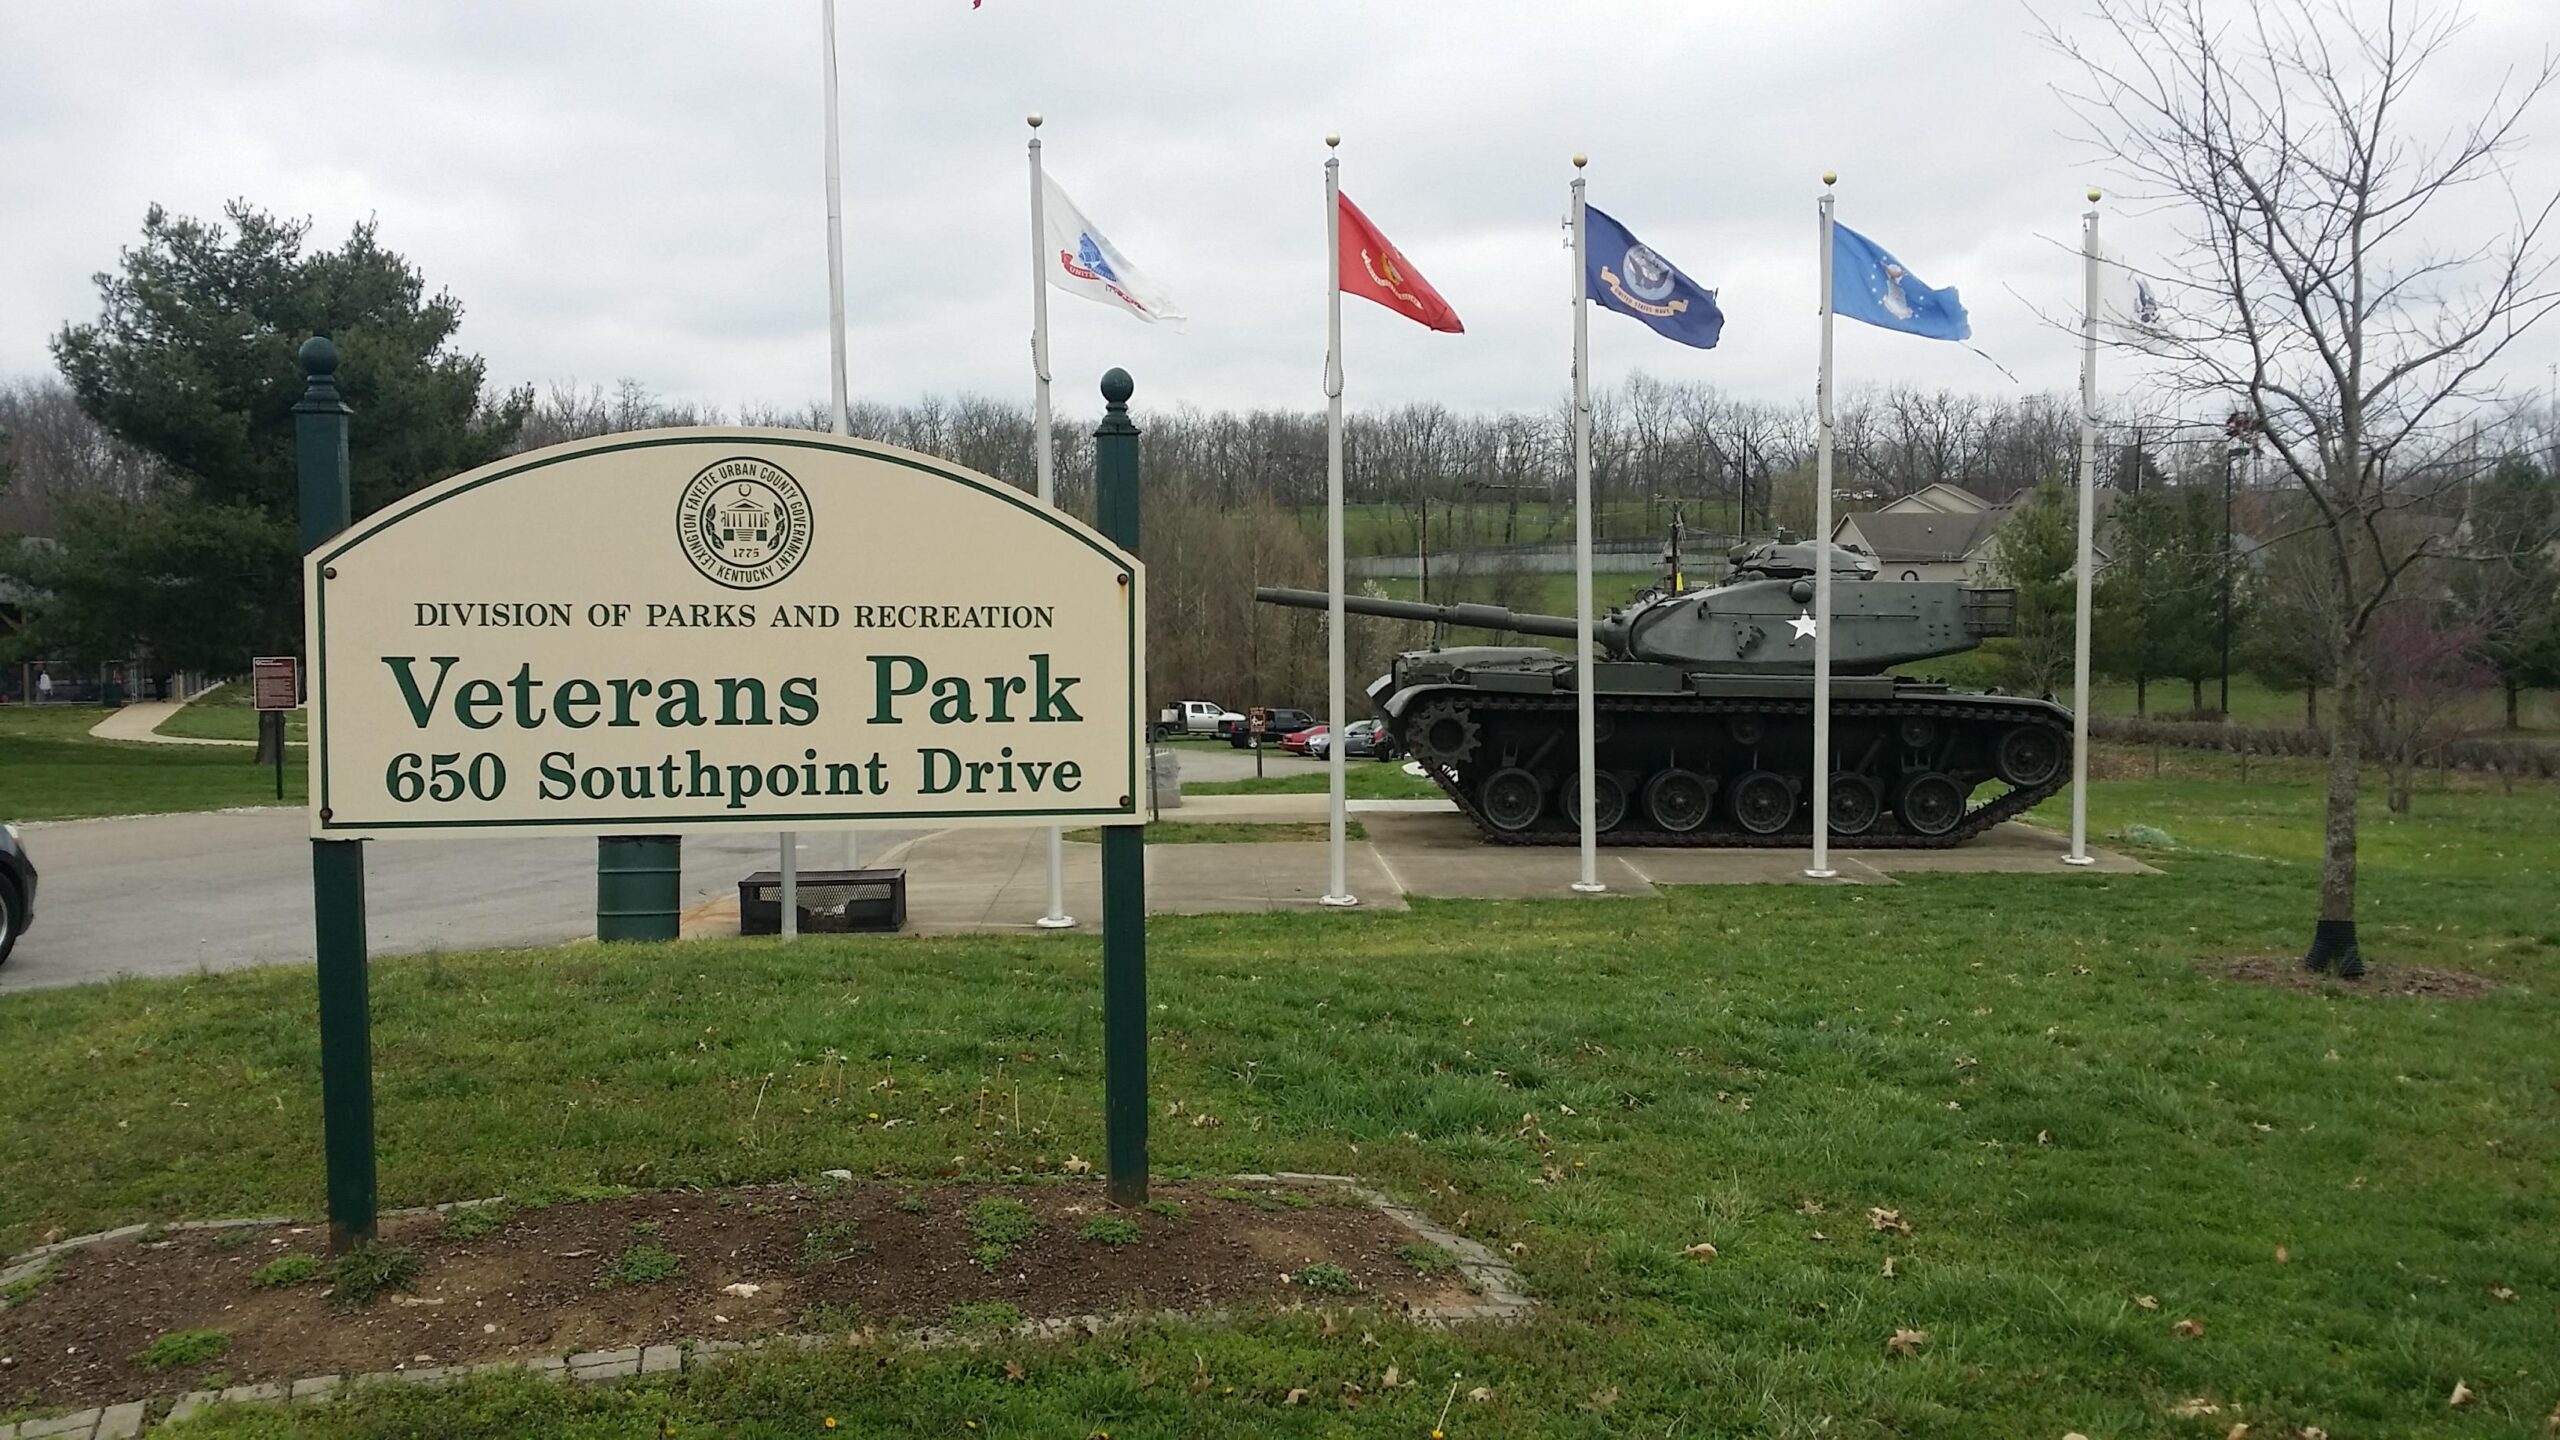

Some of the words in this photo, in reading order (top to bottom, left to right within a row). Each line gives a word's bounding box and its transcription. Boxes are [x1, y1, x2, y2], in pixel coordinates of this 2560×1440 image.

[1069, 265, 1097, 278] UNITE
[1614, 288, 1633, 304] UNITED
[1634, 301, 1653, 313] STATES
[718, 463, 757, 480] URBAN
[759, 467, 799, 500] COUNTY
[685, 472, 719, 511] FAYETTE
[683, 513, 716, 570] LEXINGTON
[775, 501, 807, 571] GOVERNMENT
[733, 547, 760, 559] 1775
[716, 564, 775, 583] KENTUCKY
[414, 603, 572, 628] DIVISION
[587, 604, 631, 628] OF
[646, 604, 756, 628] PARKS
[770, 605, 840, 628] AND
[854, 605, 1055, 629] RECREATION
[381, 656, 820, 729] Veterans
[866, 653, 1084, 725] Park
[385, 751, 507, 803] 650
[538, 749, 889, 809] Southpoint
[916, 746, 1082, 795] Drive
